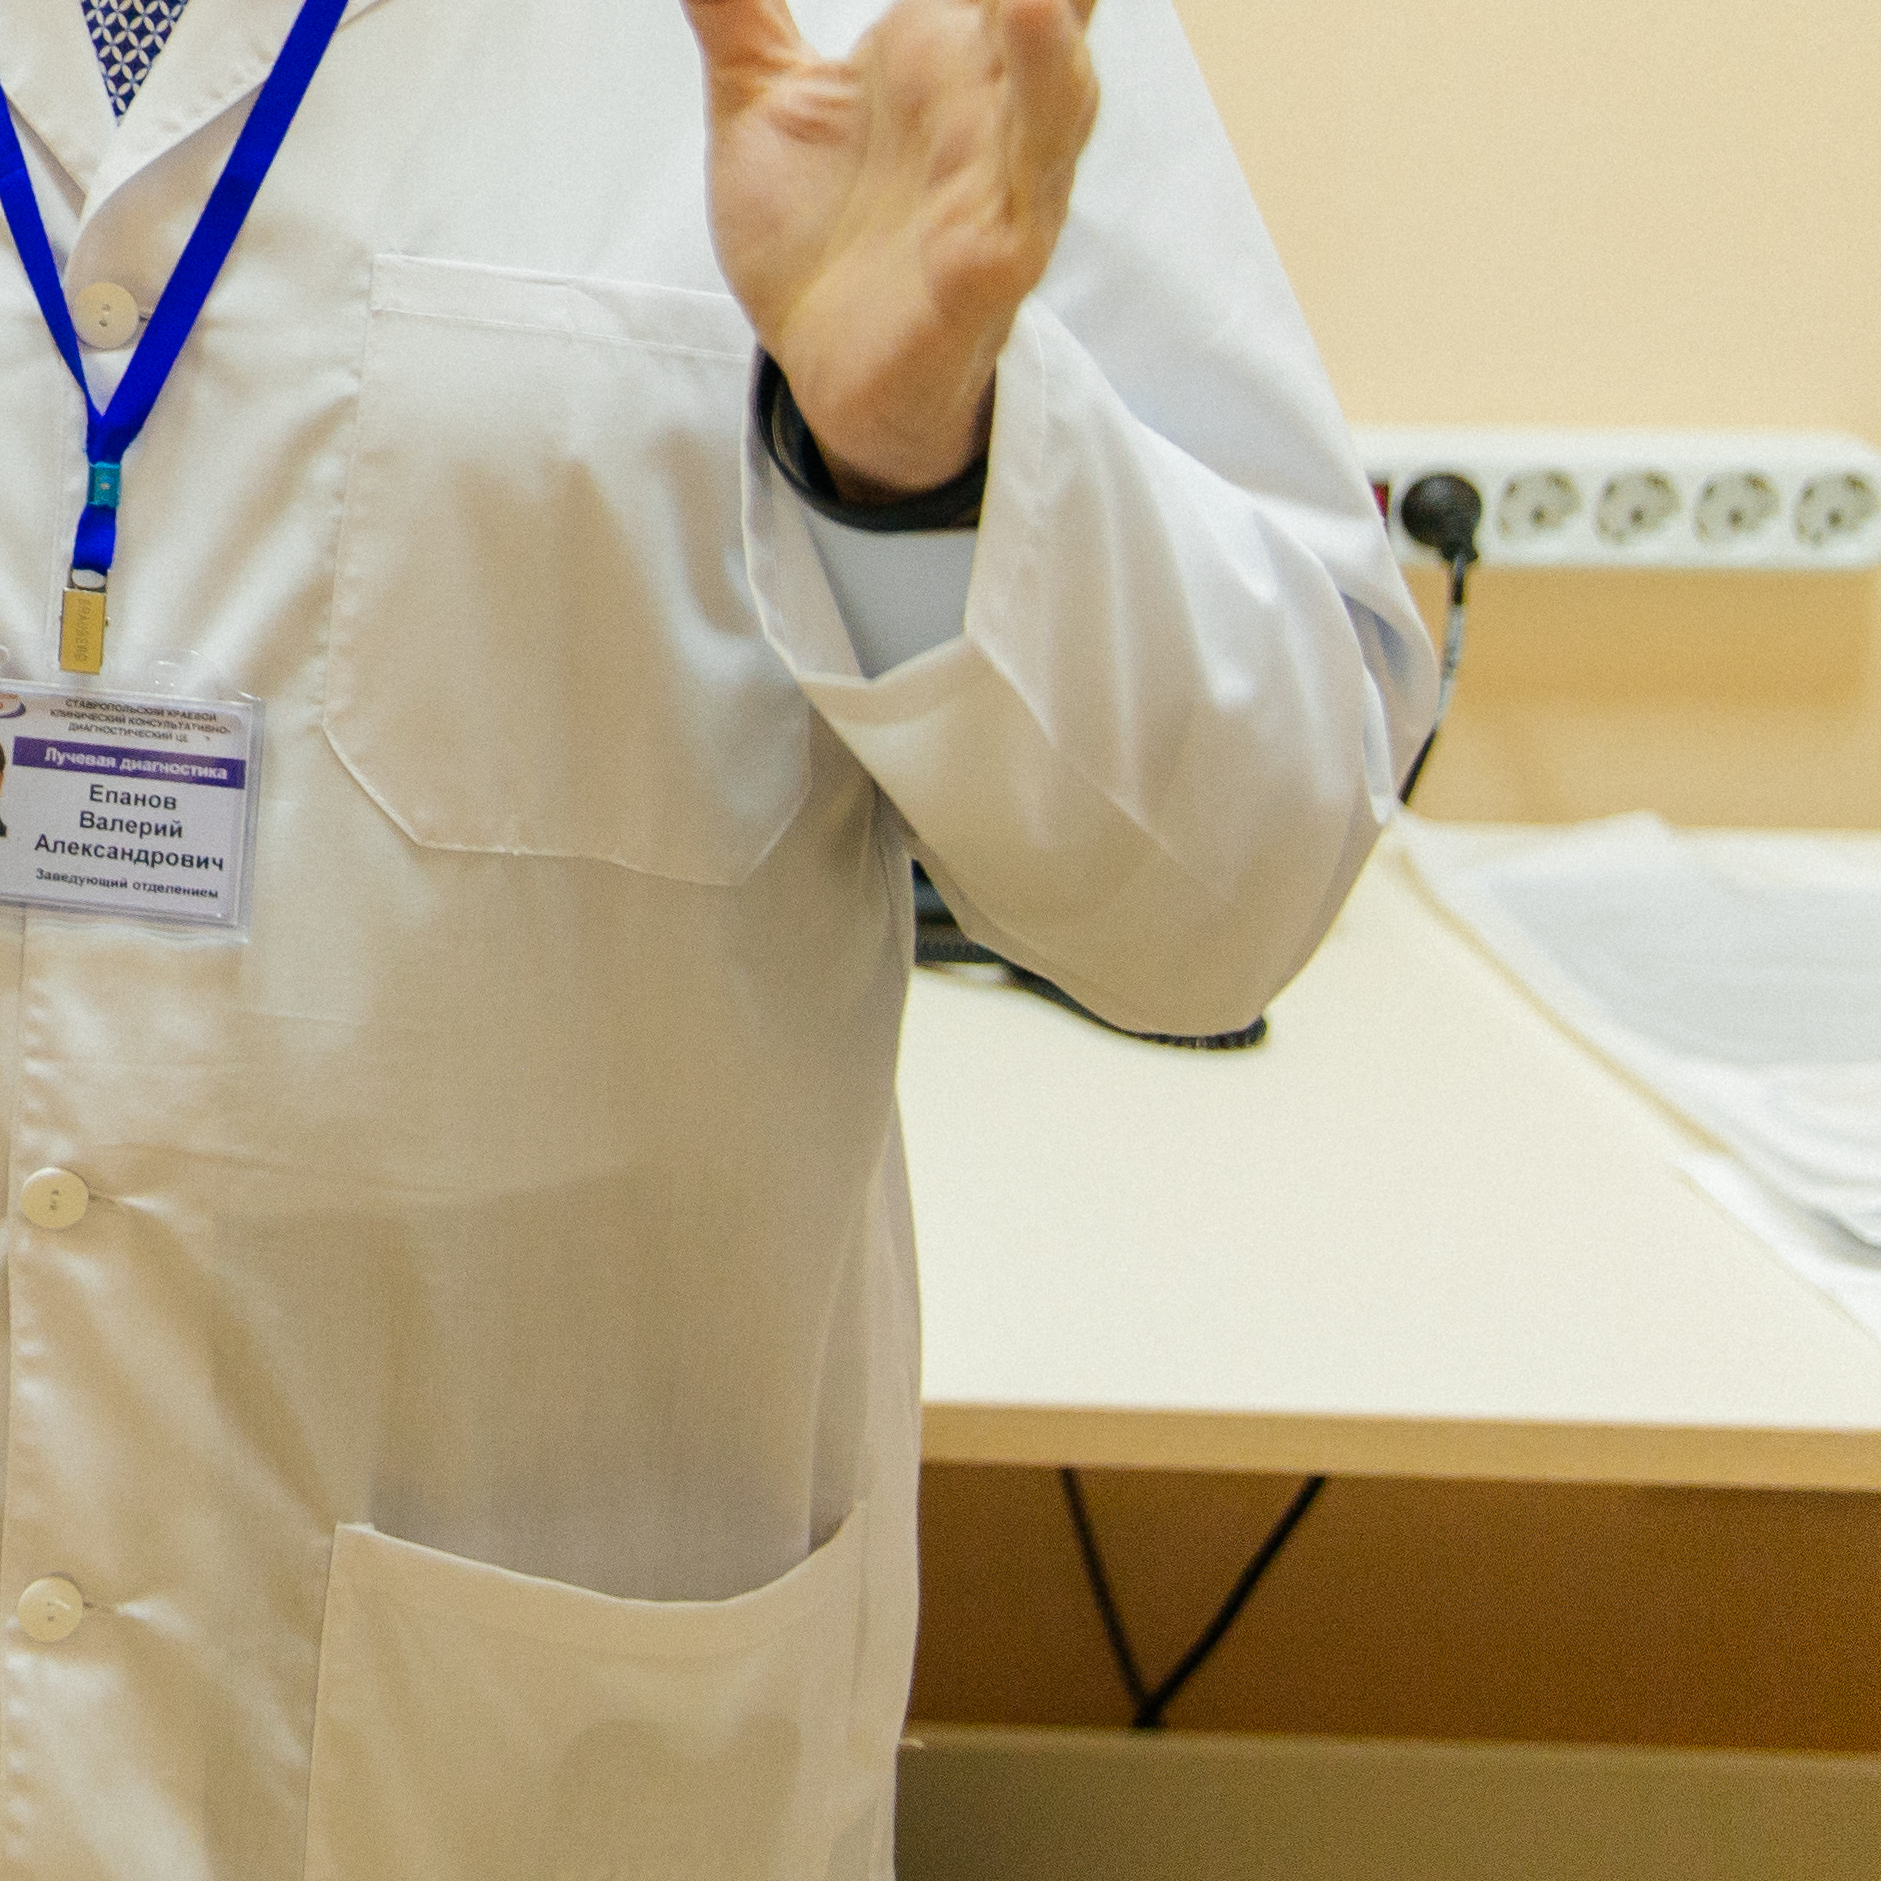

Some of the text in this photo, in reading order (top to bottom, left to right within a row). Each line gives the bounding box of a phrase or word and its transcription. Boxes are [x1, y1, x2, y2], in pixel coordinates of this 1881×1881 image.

[44, 746, 228, 780] Лучевая диагностика
[89, 784, 177, 810] Епанов
[79, 810, 183, 839] Валерий
[34, 833, 224, 871] Александрович
[36, 868, 219, 899] Заведующий отделением
